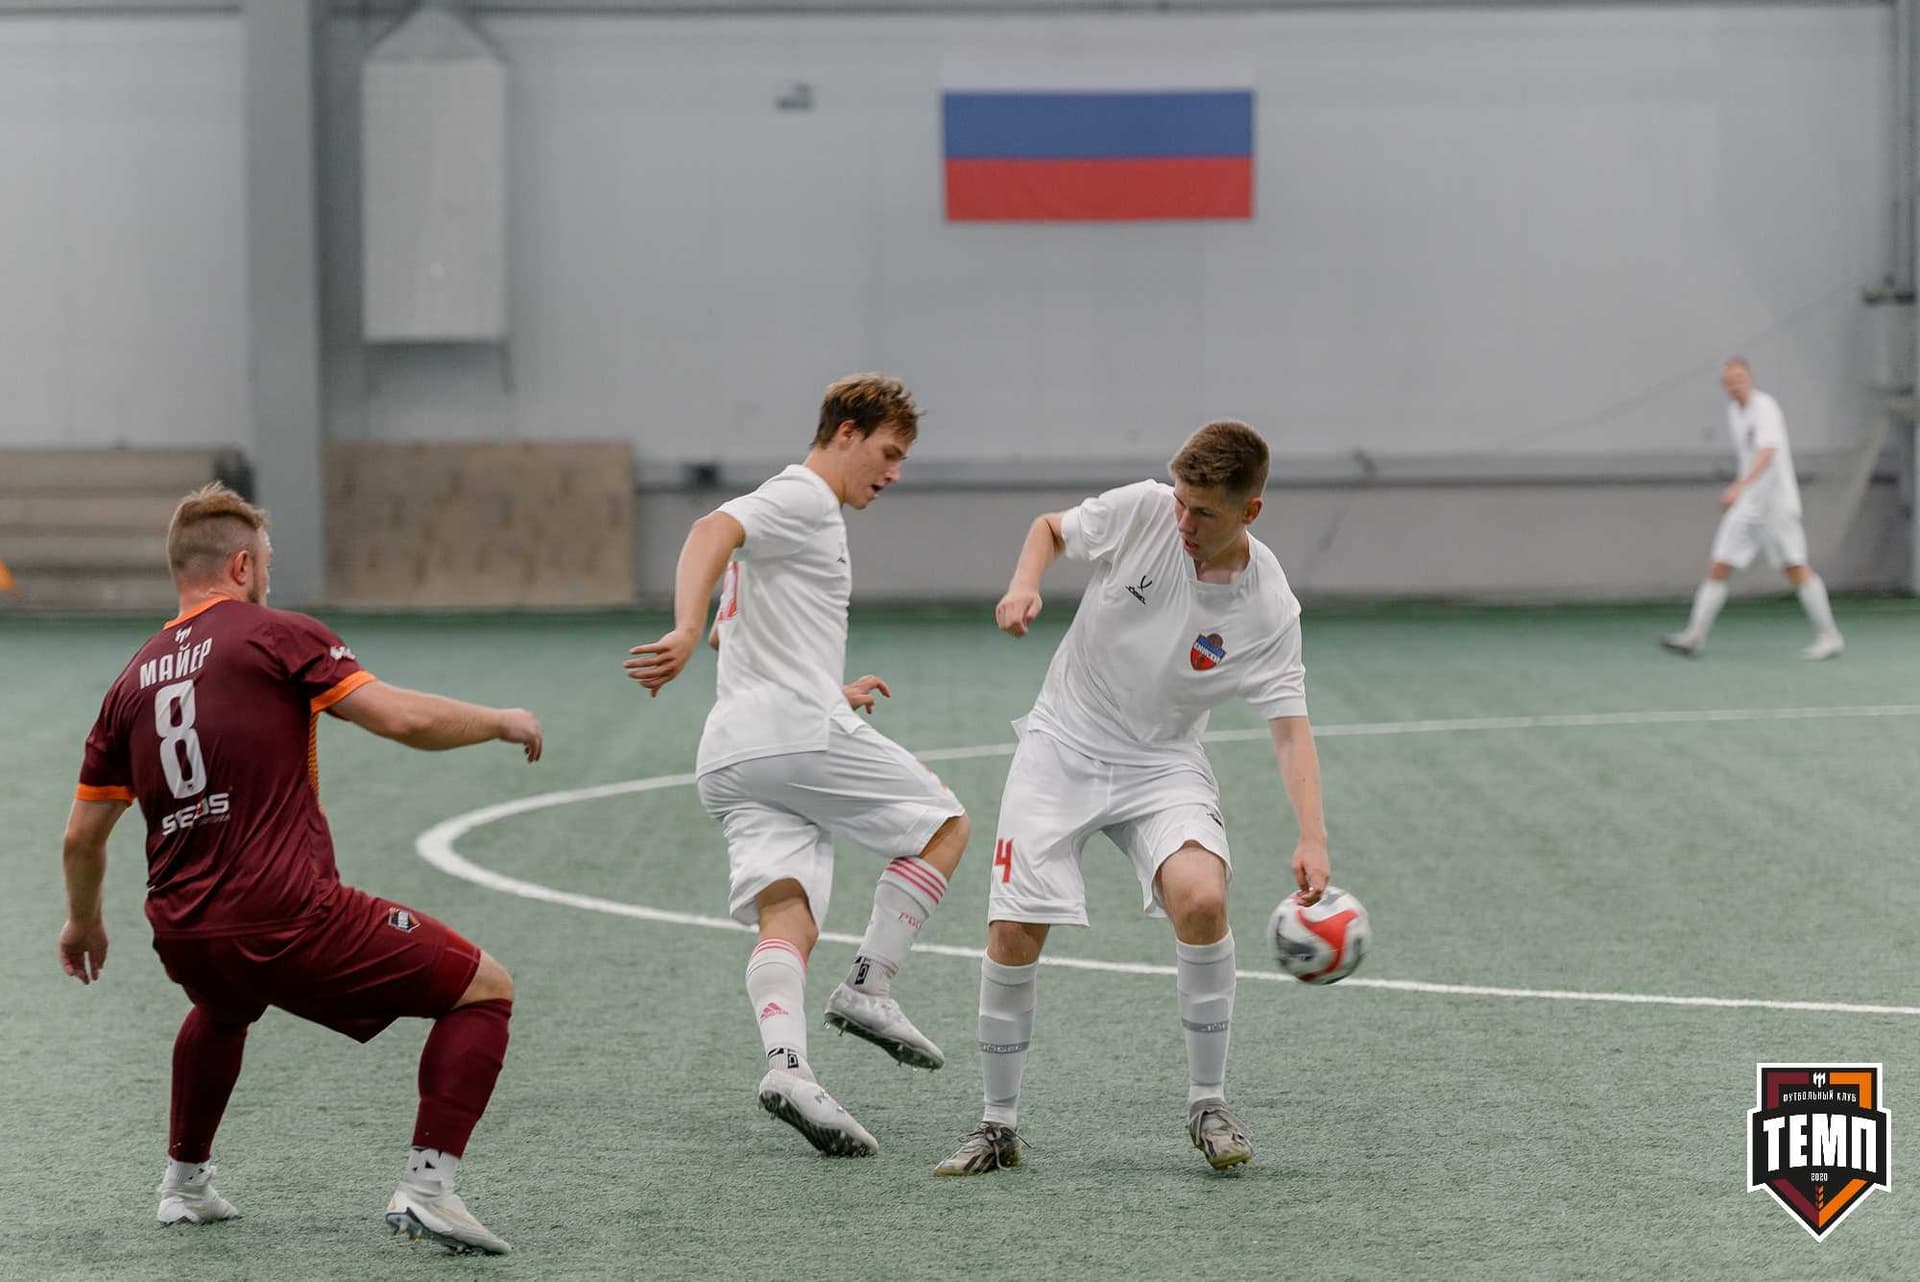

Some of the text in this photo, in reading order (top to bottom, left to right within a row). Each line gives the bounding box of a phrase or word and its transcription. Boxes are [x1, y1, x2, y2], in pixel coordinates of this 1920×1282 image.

[139, 638, 213, 689] МАЙЕР
[155, 679, 207, 799] 8
[994, 838, 1013, 883] 4
